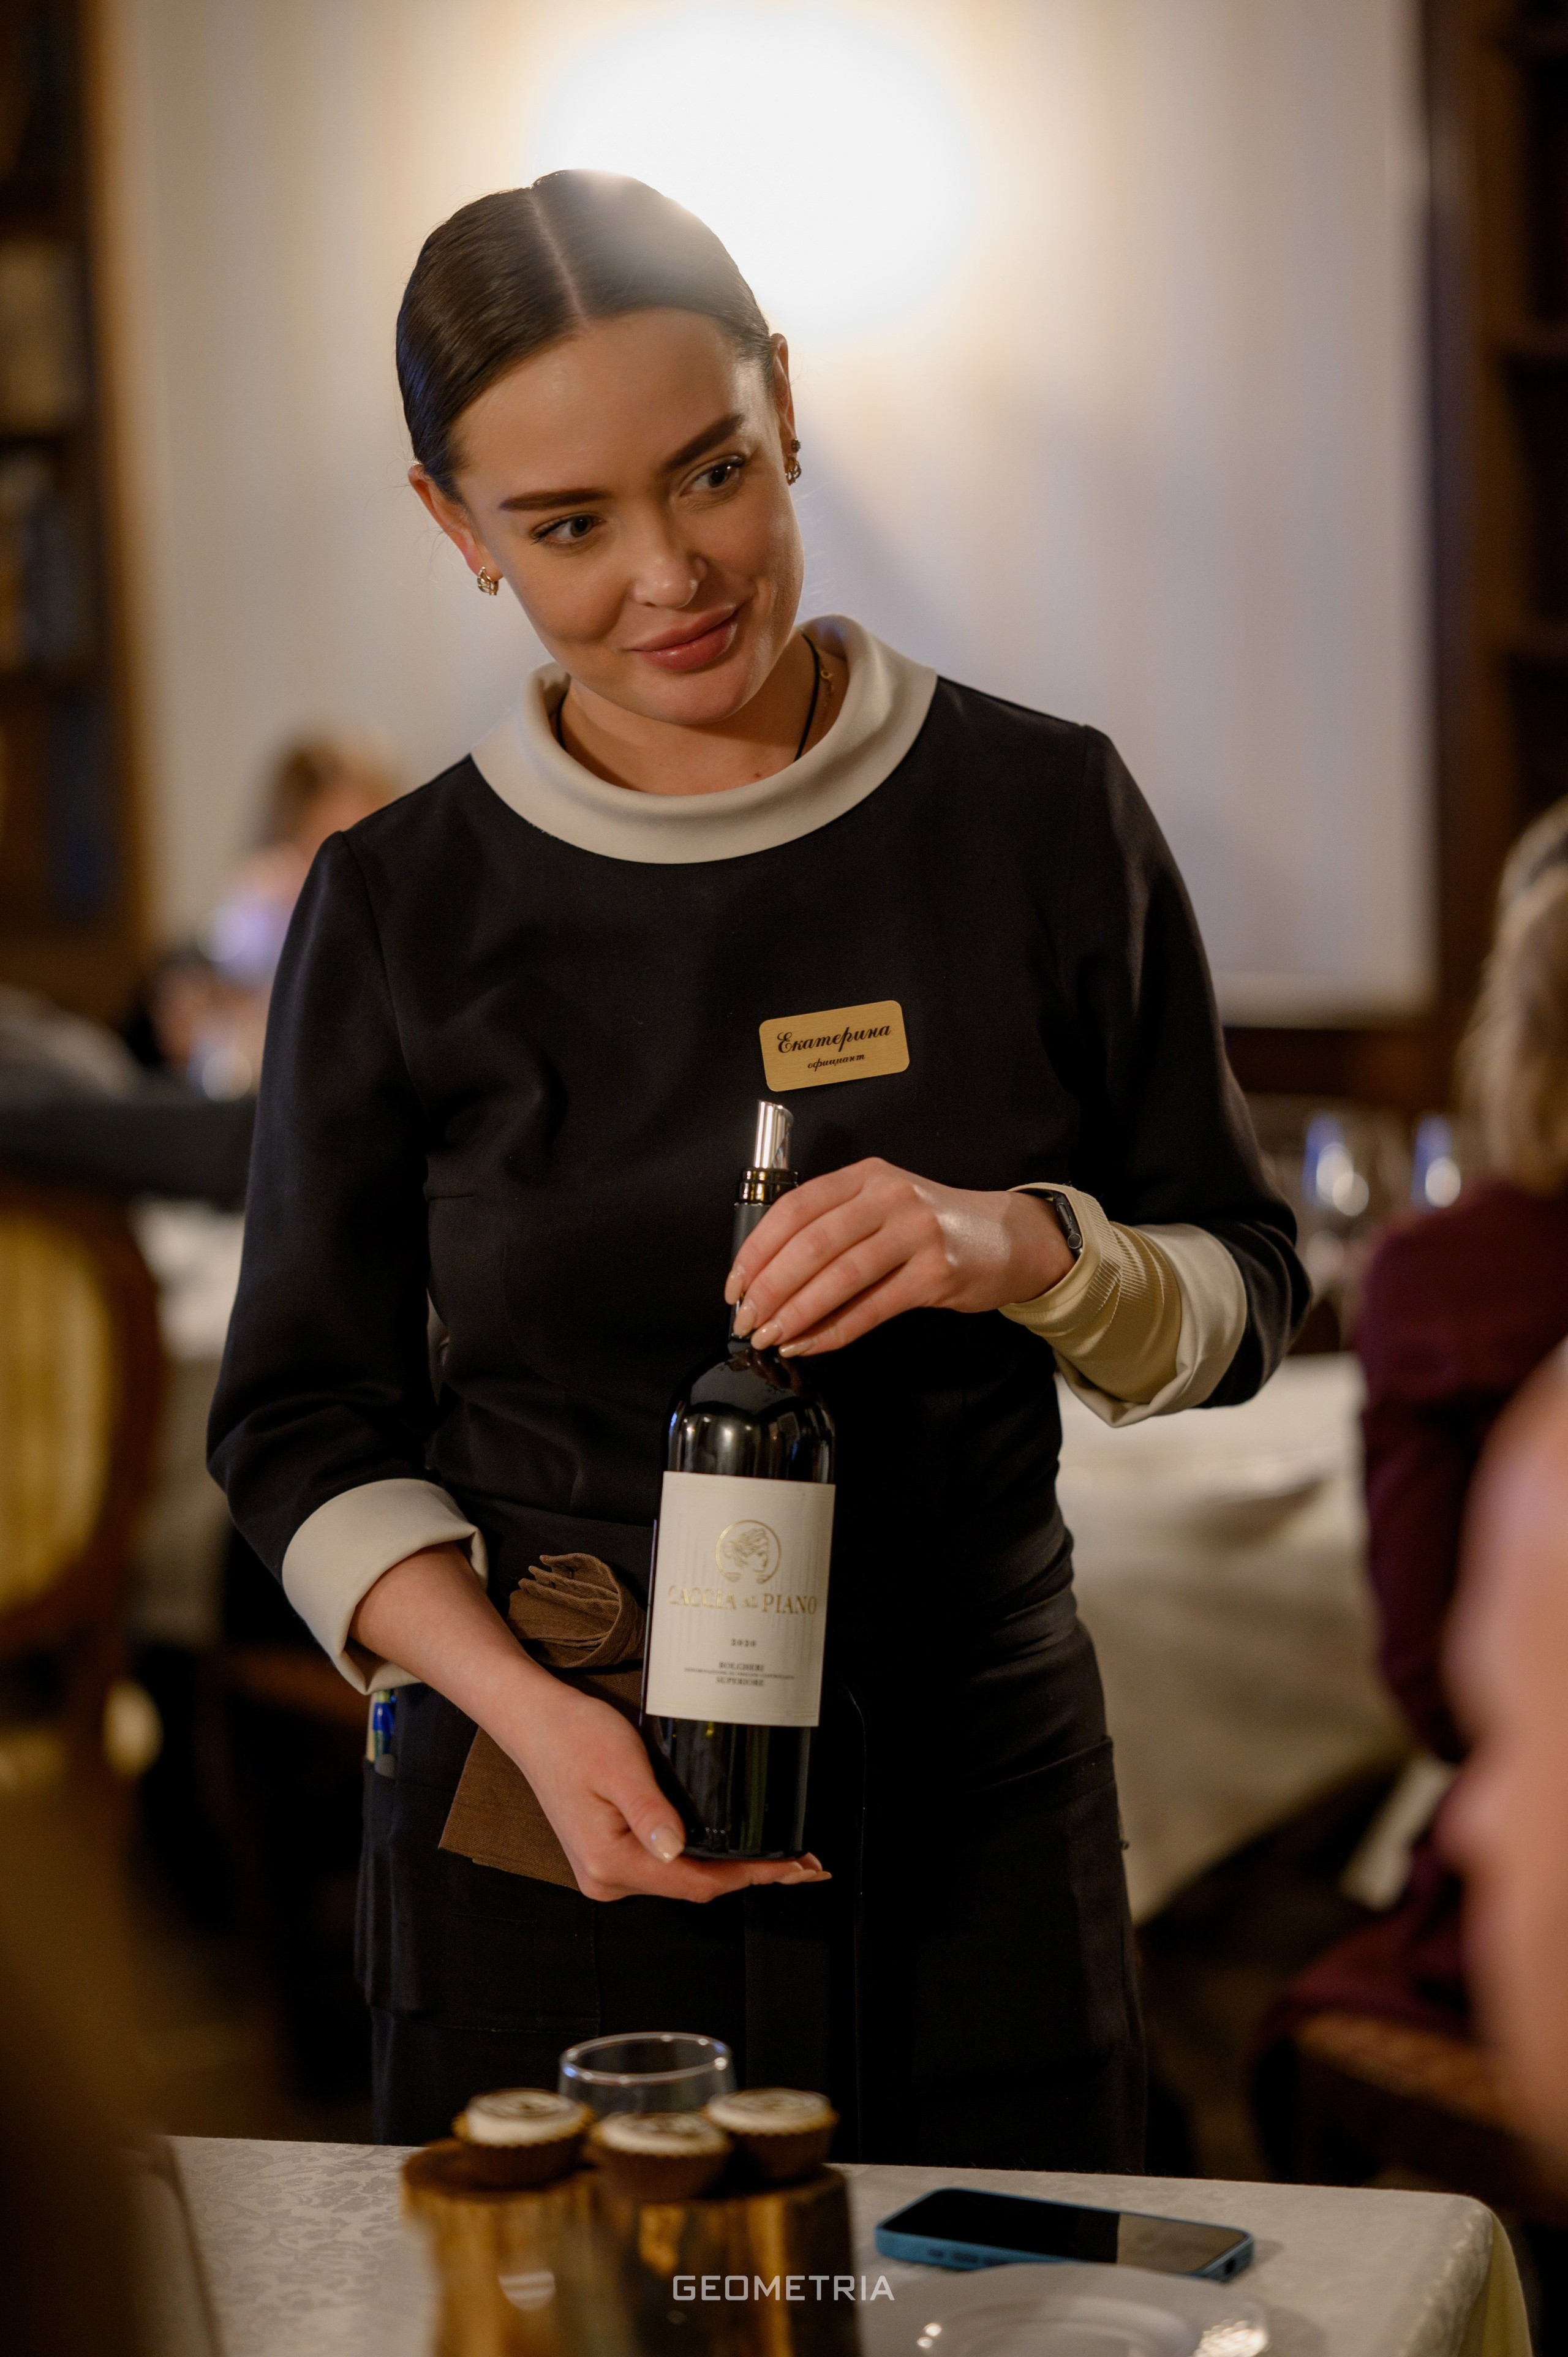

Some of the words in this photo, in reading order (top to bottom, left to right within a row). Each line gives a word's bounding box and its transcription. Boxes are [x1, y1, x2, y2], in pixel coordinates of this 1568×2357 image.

[777, 1025, 891, 1054] Екатерина
[807, 1054, 865, 1072] официант
[668, 1585, 737, 1610] CACCIA
[762, 1593, 818, 1615] PIANO
[731, 1638, 757, 1648] 2020
